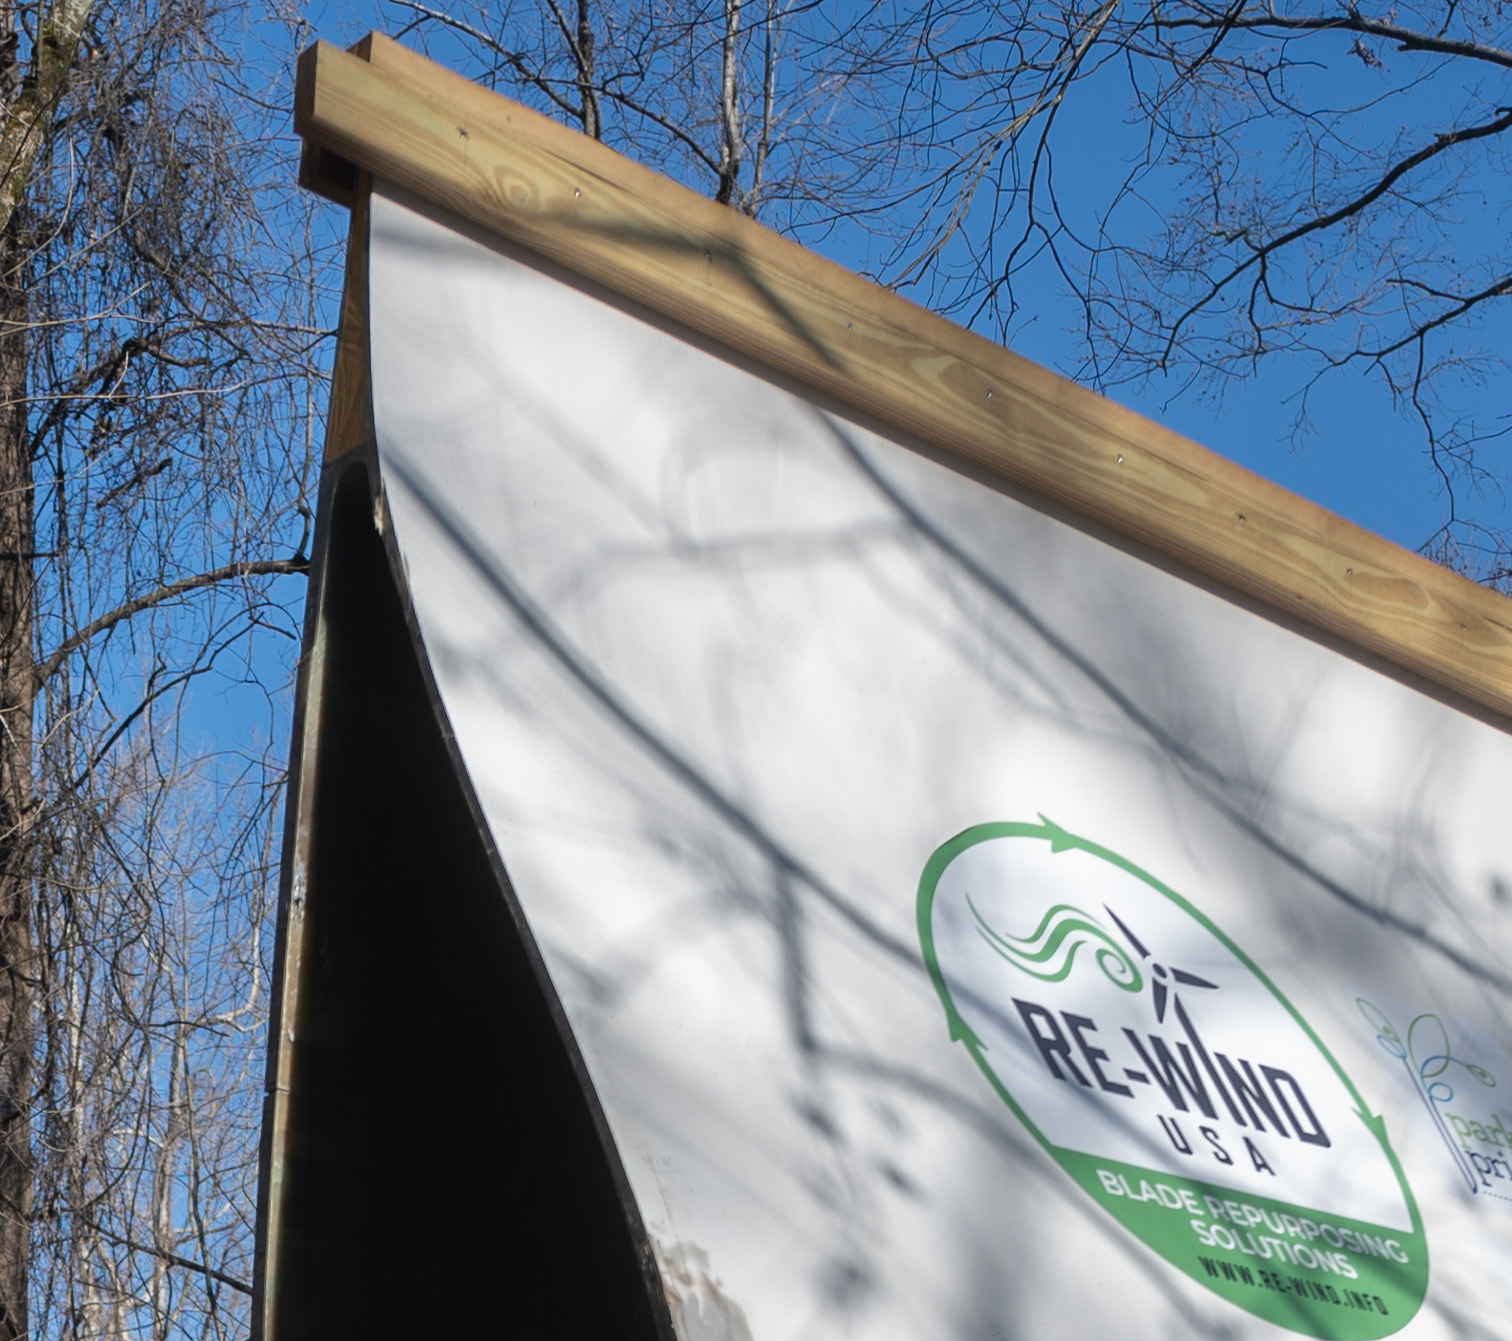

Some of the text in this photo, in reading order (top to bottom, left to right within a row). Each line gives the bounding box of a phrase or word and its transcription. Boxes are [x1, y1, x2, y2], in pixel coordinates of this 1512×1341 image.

[1011, 993, 1331, 1148] RE-WIND
[1096, 1168, 1409, 1264] BLADE REPURPOSING
[1191, 1220, 1358, 1280] SOLUTIONS
[1198, 1256, 1389, 1316] WWW.RE-WIND.INFO
